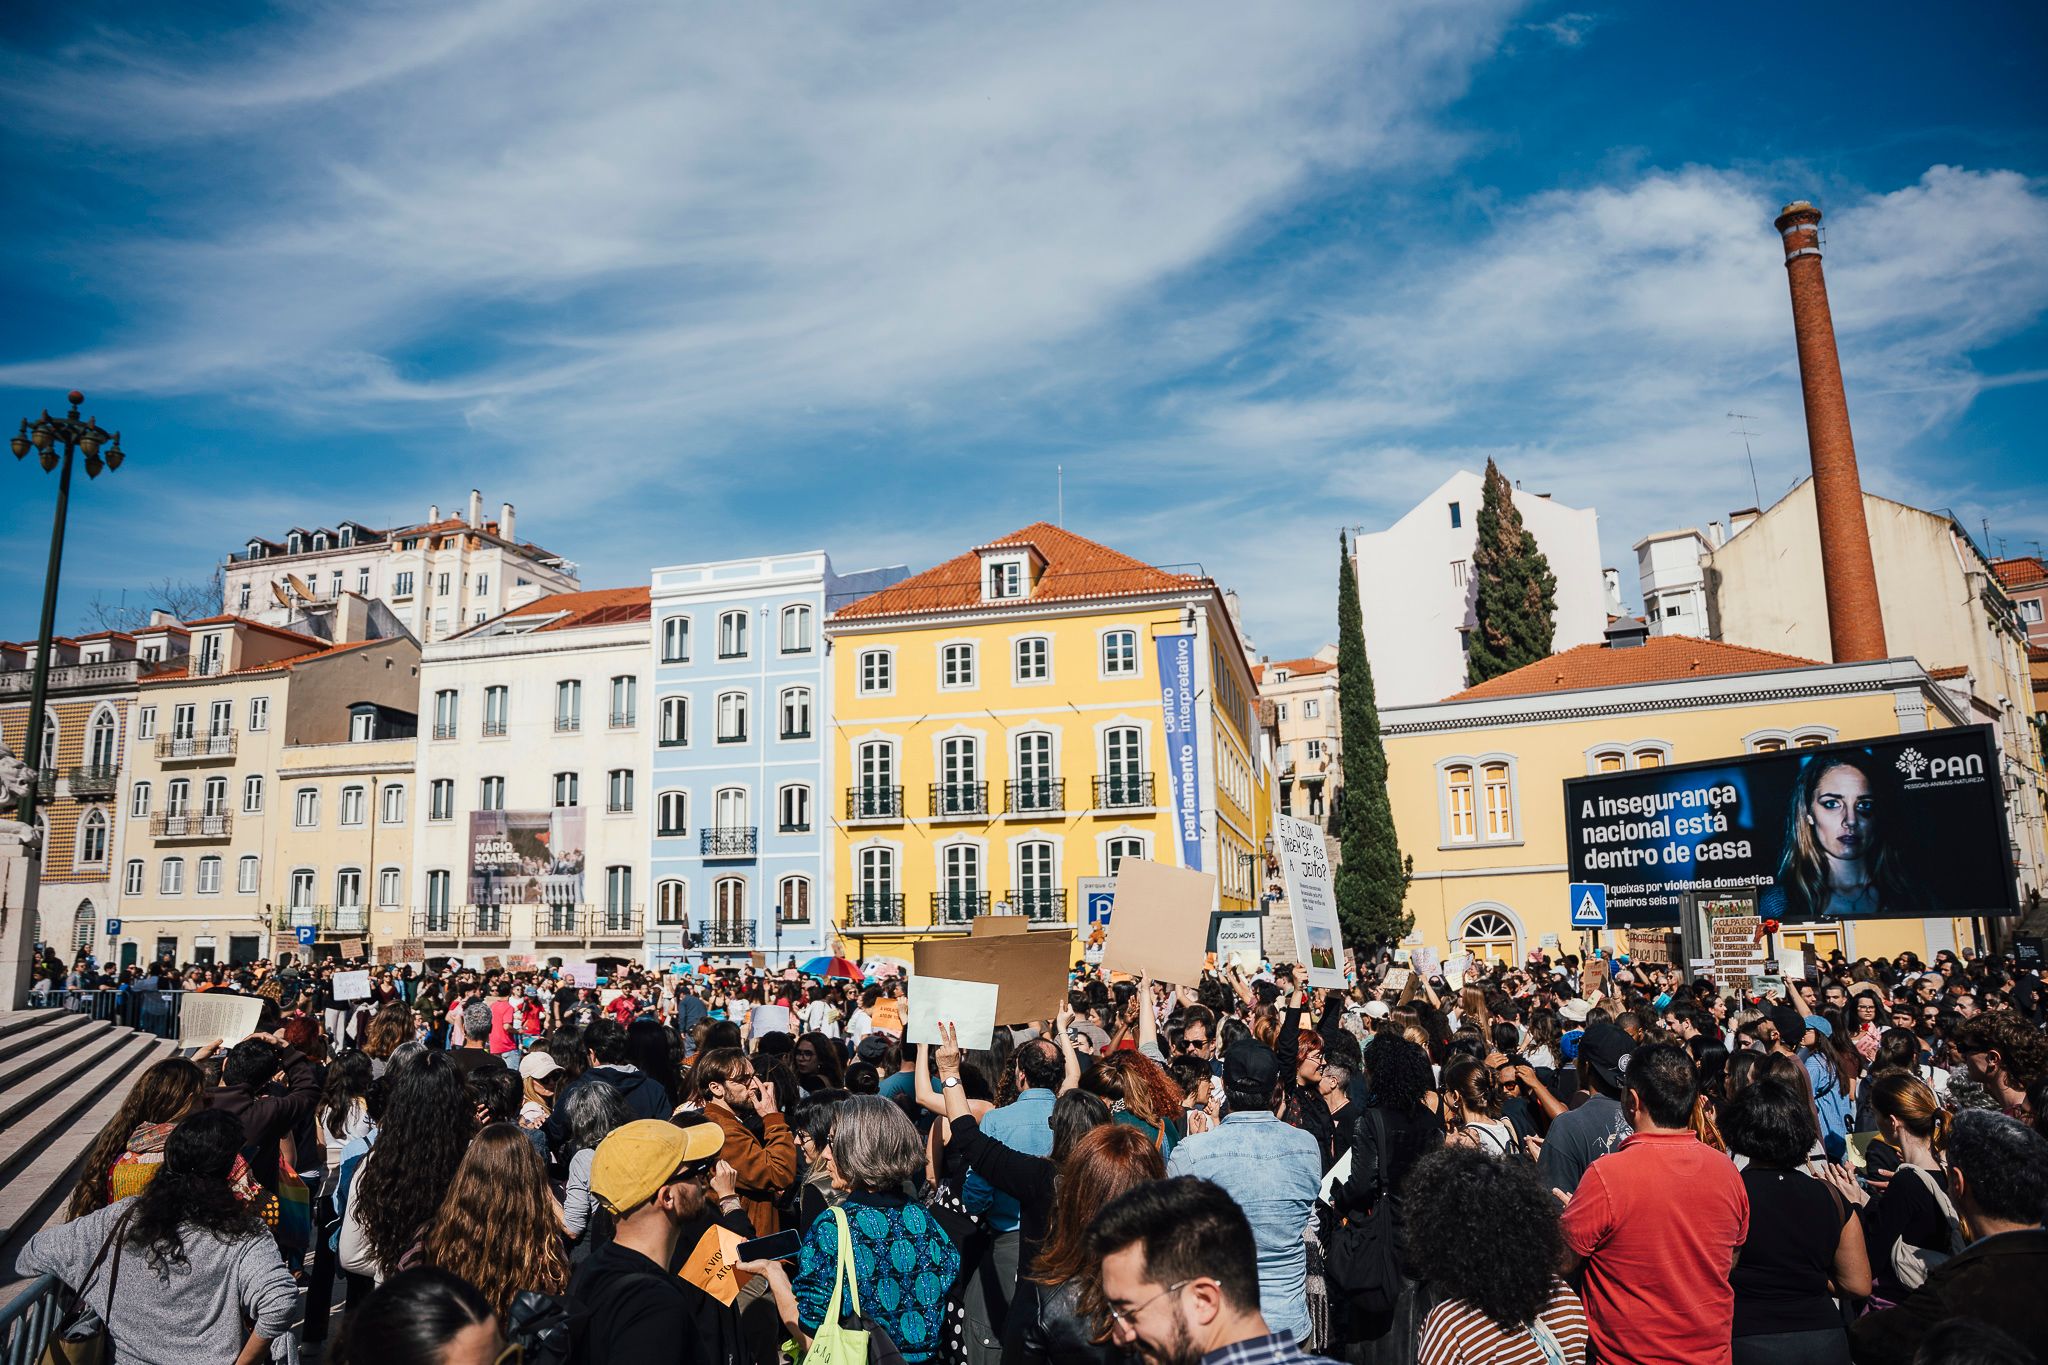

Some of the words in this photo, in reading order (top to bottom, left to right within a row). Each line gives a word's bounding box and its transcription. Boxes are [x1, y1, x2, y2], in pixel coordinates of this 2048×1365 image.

[1178, 638, 1189, 733] interpretativo
[1164, 687, 1174, 733] centro
[1930, 754, 1984, 779] PAN
[1181, 744, 1199, 842] parlamento
[1581, 799, 1595, 819] A
[1598, 785, 1737, 817] insegurança
[1582, 815, 1670, 844] nacional
[1675, 811, 1728, 836] está
[475, 839, 513, 853] MÁRIO
[1584, 847, 1658, 870] dentro
[1663, 842, 1690, 865] de
[1694, 839, 1752, 862] casa
[474, 852, 520, 864] SOARES
[1610, 883, 1645, 897] queixas
[1646, 883, 1662, 894] por
[1664, 878, 1712, 891] violência
[1713, 875, 1774, 888] doméstica
[1096, 900, 1112, 921] P
[1648, 895, 1667, 906] seis
[109, 921, 118, 933] P
[300, 929, 311, 942] P
[1713, 926, 1754, 935] VIOLADORES
[703, 1267, 712, 1275] A
